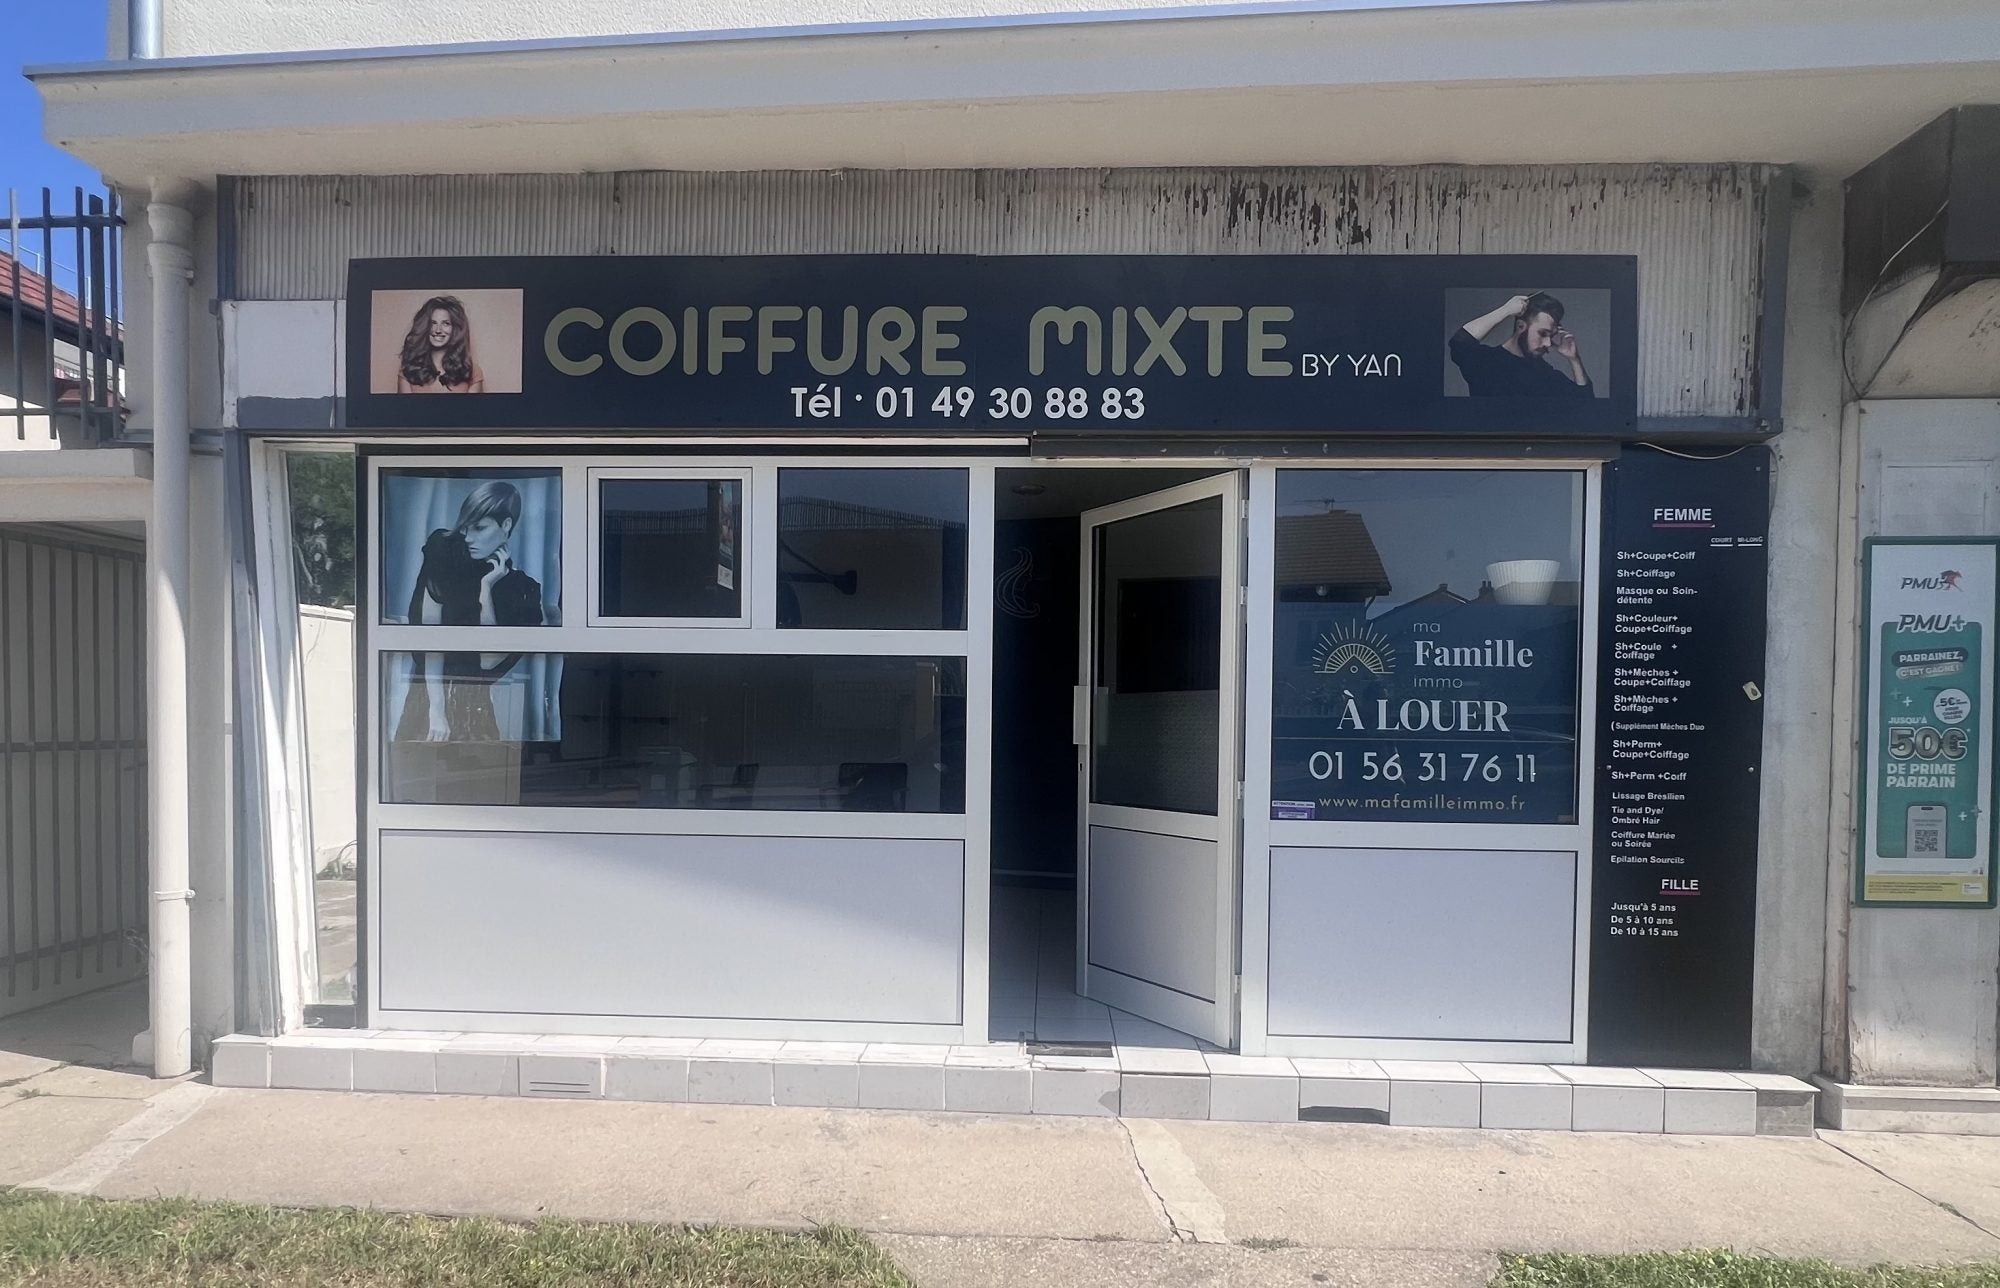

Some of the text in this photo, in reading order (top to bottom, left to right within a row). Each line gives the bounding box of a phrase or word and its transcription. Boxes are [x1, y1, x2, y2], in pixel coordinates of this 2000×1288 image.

[543, 305, 1402, 377] COIFFURE MIXTE BY YAN
[791, 383, 841, 418] Tél
[875, 386, 913, 418] 01
[931, 386, 975, 419] 49
[988, 387, 1032, 419] 30
[1044, 387, 1088, 419] 88
[1100, 387, 1145, 419] 83
[1653, 508, 1712, 521] FEMME
[1617, 551, 1696, 561] Sh+Coupe+Coiff
[1617, 569, 1676, 579] Sh+Coiffage
[1901, 577, 1938, 590] PMU
[1616, 587, 1654, 597] Masque
[1616, 596, 1653, 604] détente
[1616, 614, 1678, 623] Sh+Couleur+
[1898, 614, 1965, 632] PMU+
[1413, 621, 1440, 633] ma
[1615, 625, 1693, 635] Coupe+Coiffage
[1414, 639, 1533, 668] Famille
[1614, 651, 1655, 661] Coiffage
[1899, 650, 1963, 663] PARRAINEZ,
[1614, 668, 1670, 677] Sh+Mèches
[1413, 676, 1463, 688] immo
[1614, 678, 1691, 688] Coupe+Coiffage
[1614, 694, 1669, 703] Sh+Mèches
[1337, 689, 1510, 732] À LOUER
[1613, 704, 1654, 713] Coiffage
[1612, 739, 1662, 748] Sh+Perm+
[1612, 750, 1689, 760] Coupe+Coiffage
[1308, 751, 1536, 783] 01 56 31 76 11
[1887, 763, 1956, 775] DE PRIME
[1611, 771, 1687, 781] Sh+Perm +Coiff
[1886, 776, 1955, 788] PARRAIN
[1612, 792, 1685, 801] Lissage Brésilien
[1319, 793, 1526, 811] www.mafamilleimmo.fr
[1612, 806, 1625, 814] Tie
[1626, 806, 1642, 814] and
[1611, 816, 1660, 825] Ombré Hair
[1611, 831, 1645, 839] Coiffure
[1625, 840, 1652, 848] Soirée
[1610, 855, 1685, 865] Epilation Sourcils
[1661, 879, 1699, 890] FILLE
[1611, 902, 1676, 912] Jusqu'à 5 ans
[1611, 915, 1673, 925] De 5 à 10 ans
[1610, 927, 1679, 937] De 10 à 15 ans
